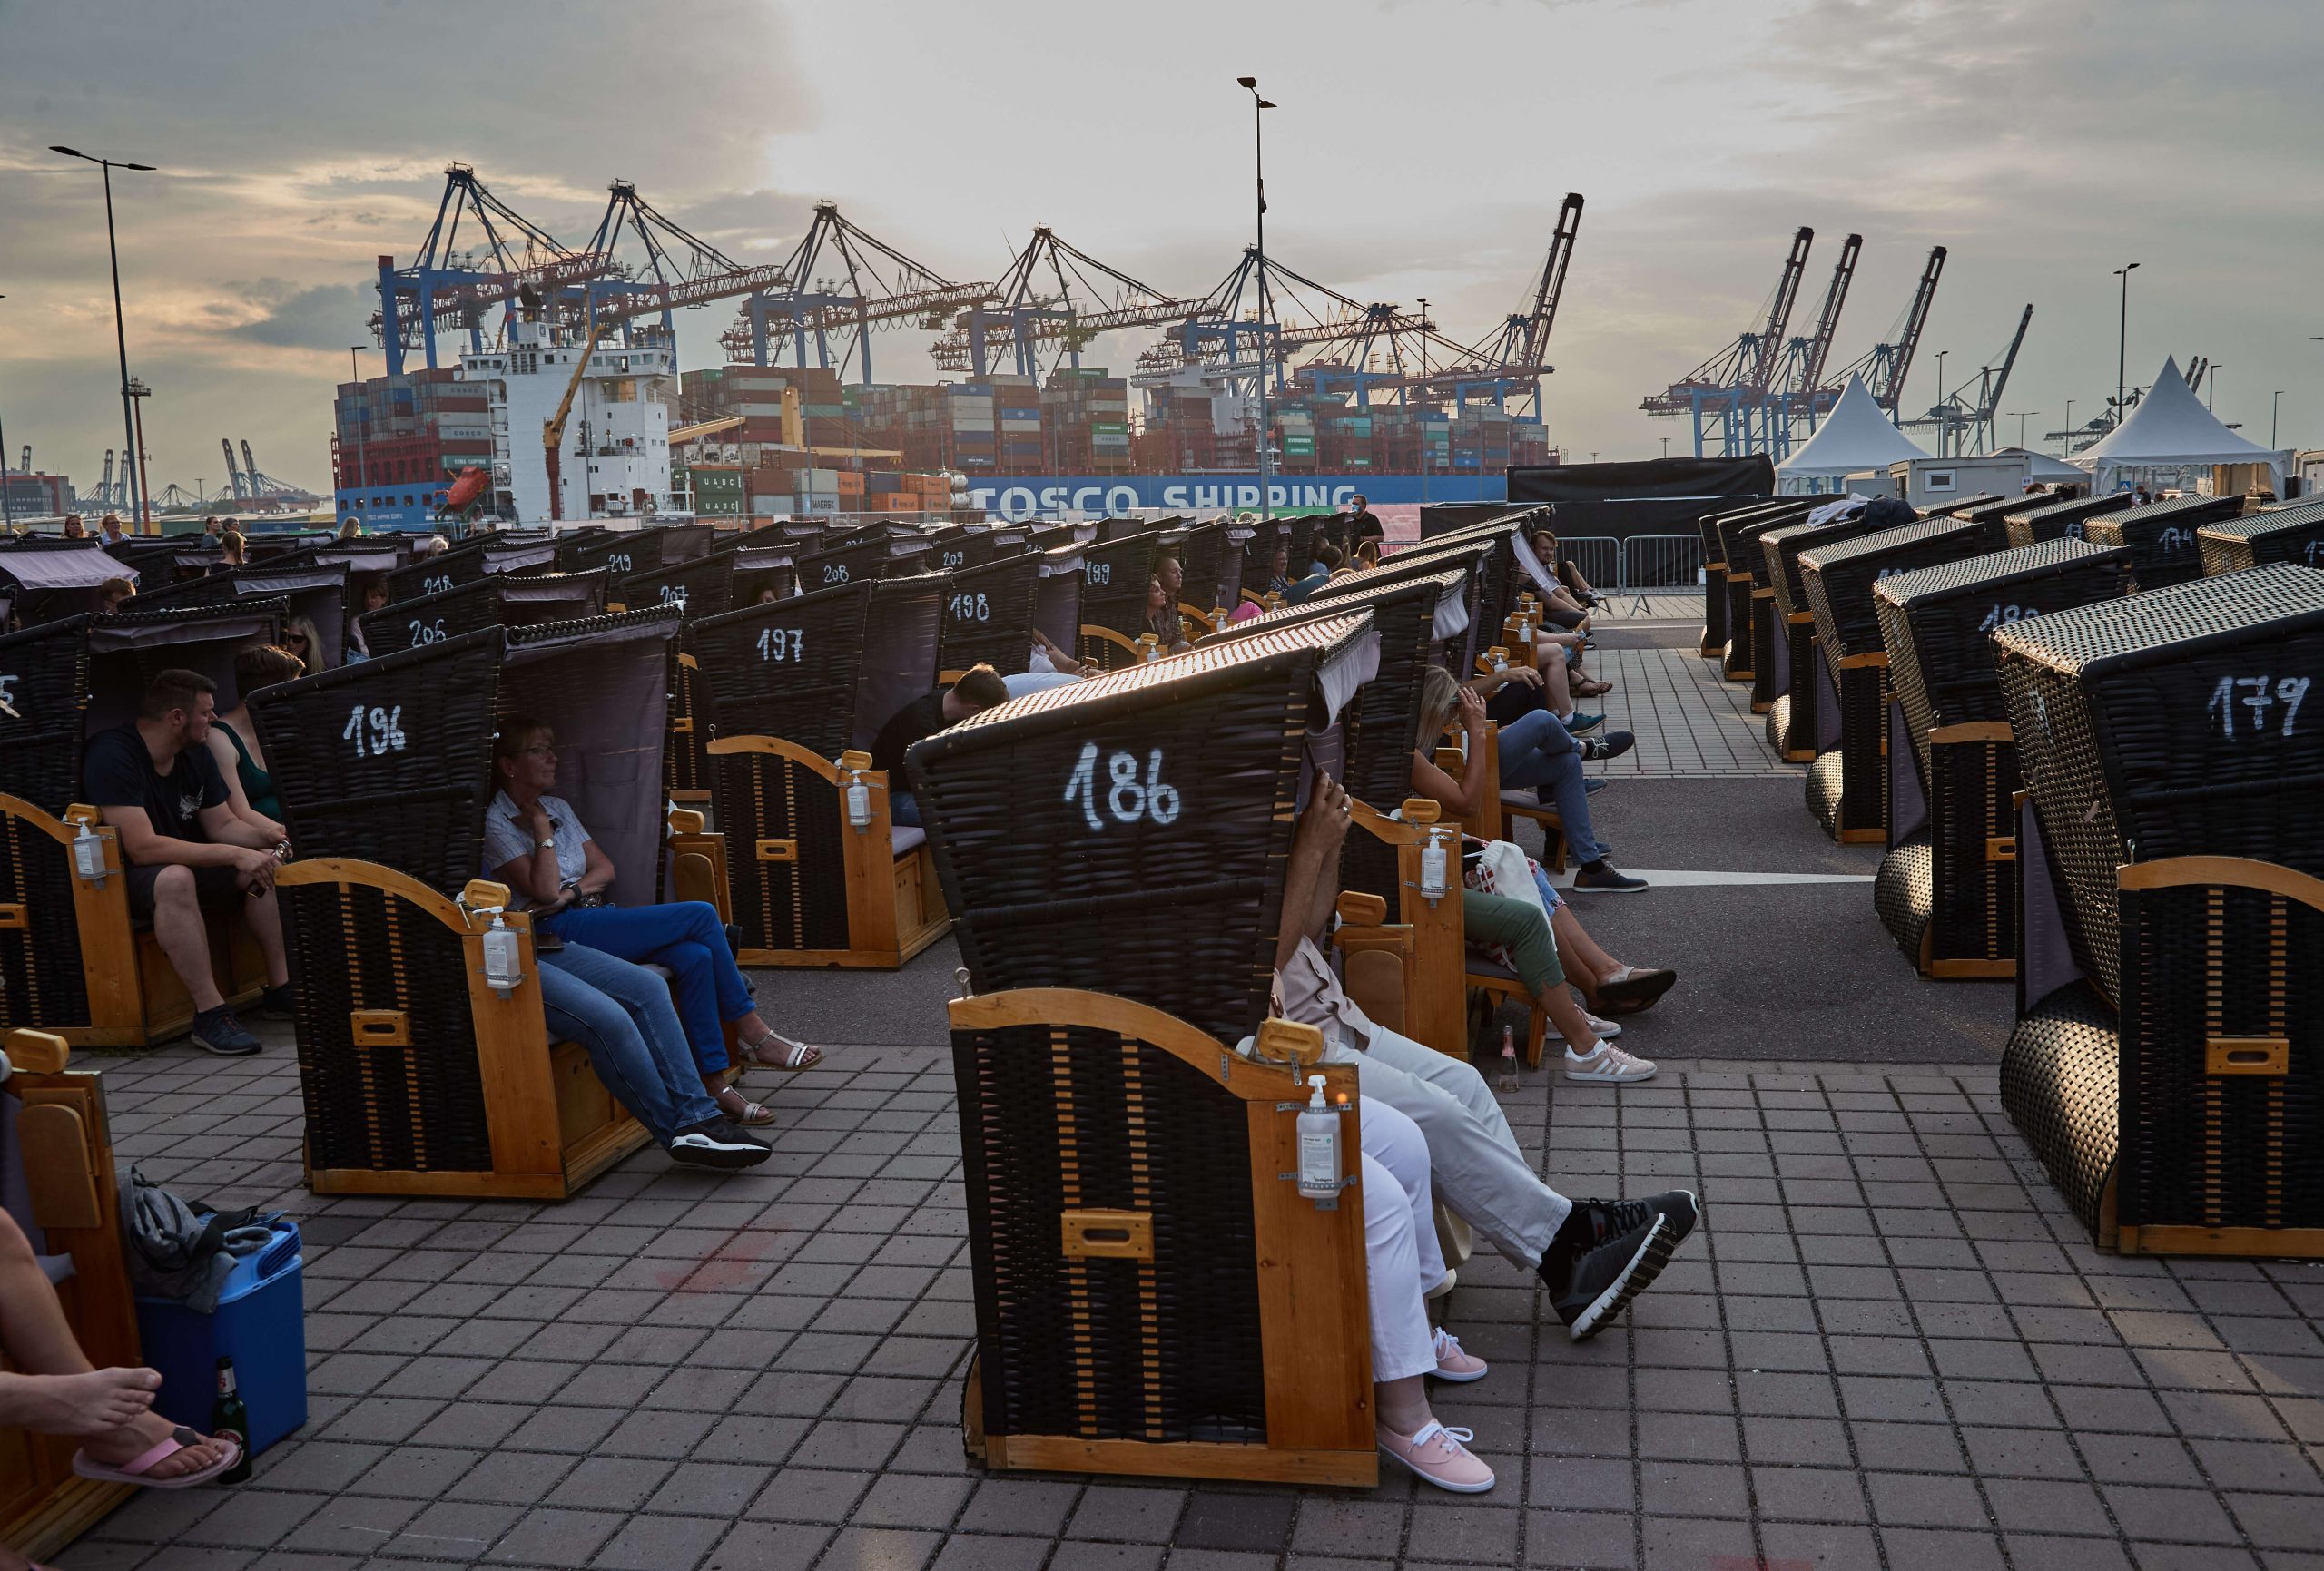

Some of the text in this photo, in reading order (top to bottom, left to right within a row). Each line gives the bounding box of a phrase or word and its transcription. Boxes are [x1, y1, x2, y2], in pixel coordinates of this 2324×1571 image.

[704, 477, 734, 486] UASC
[705, 502, 736, 510] UASC
[812, 500, 835, 510] MAERSK
[2158, 526, 2193, 553] 174
[608, 554, 632, 573] 219
[943, 551, 964, 566] 209
[823, 565, 850, 583] 208
[1085, 561, 1111, 584] 199
[423, 575, 454, 596] 218
[950, 592, 990, 622] 198
[409, 618, 447, 649] 206
[756, 627, 803, 663] 197
[2208, 675, 2310, 737] 179
[342, 704, 407, 758] 196
[1063, 741, 1180, 832] 186
